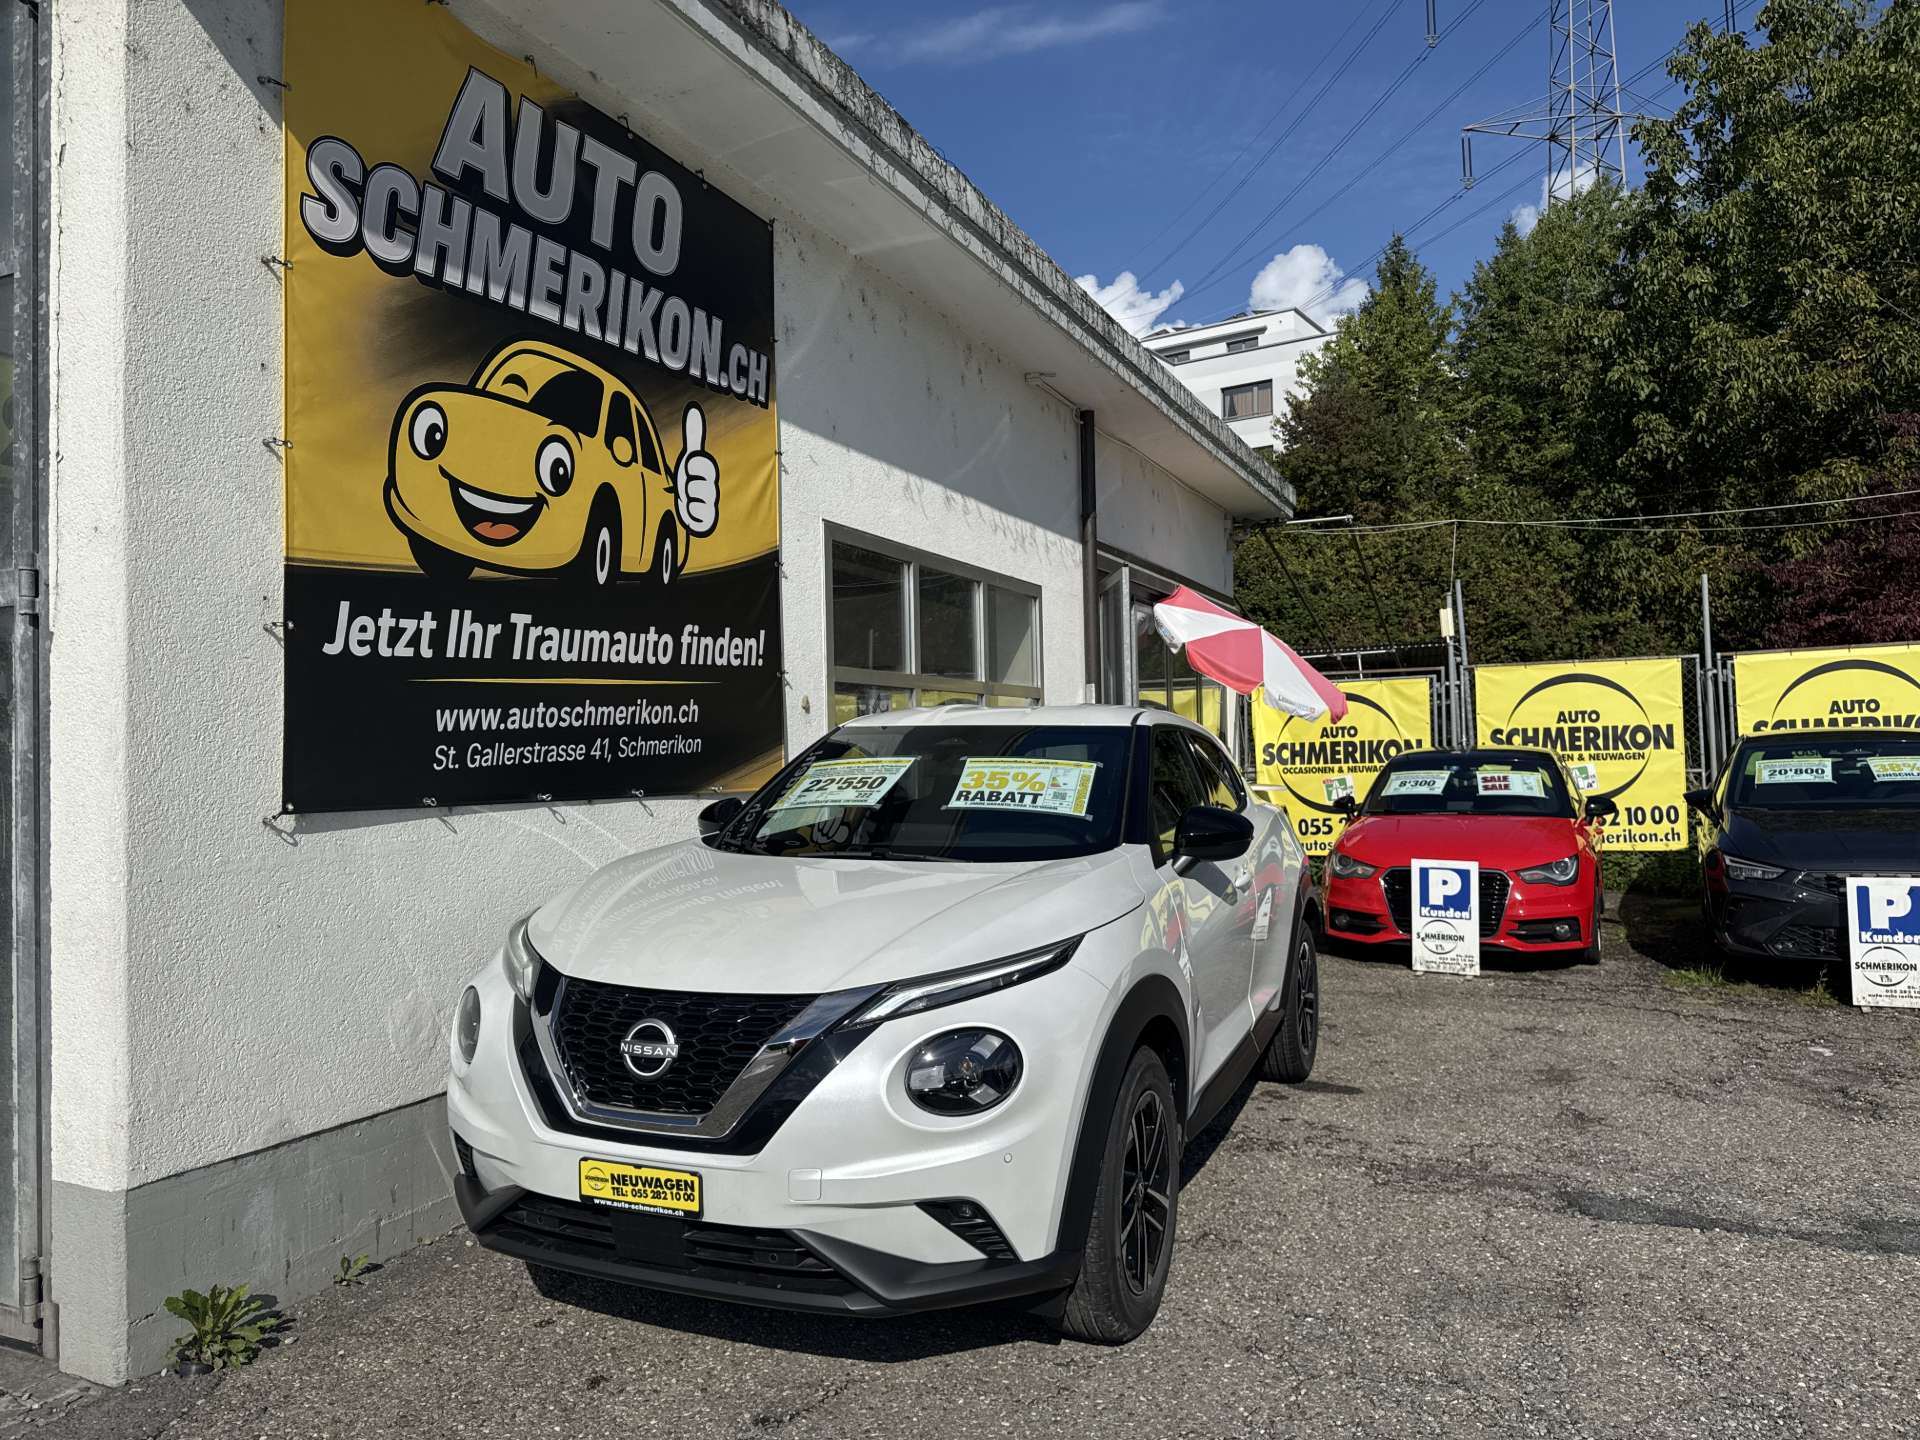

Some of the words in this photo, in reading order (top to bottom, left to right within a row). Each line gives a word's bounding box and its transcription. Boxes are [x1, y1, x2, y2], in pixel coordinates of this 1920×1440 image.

[431, 65, 684, 277] AUTO
[301, 136, 769, 405] SCHMERIKON.CH
[322, 600, 437, 659] Jetzt
[446, 608, 501, 660] Ihr
[509, 613, 674, 664] Traumauto
[680, 624, 766, 667] finden!
[435, 698, 699, 732] www.autoschmerikon.ch
[1828, 698, 1881, 715] AUTO
[1556, 709, 1601, 725] AUTO
[1320, 725, 1358, 739] AUTO
[1489, 723, 1675, 751] SCHMERIKON
[433, 744, 460, 771] St.
[466, 745, 586, 768] Gallerstrasse
[590, 739, 613, 763] 41,
[618, 735, 702, 758] Schmerikon
[1588, 751, 1645, 762] NEUWAGEN
[1282, 766, 1335, 775] OCCASIONEN
[1337, 766, 1344, 774] &
[1481, 775, 1511, 783] SALE
[1767, 767, 1826, 777] 20'800
[801, 775, 888, 793] 22'550
[961, 770, 1047, 793] 35%
[1398, 780, 1437, 788] 8'300
[1482, 783, 1512, 791] SALE
[955, 790, 1043, 805] RABATT
[1624, 806, 1647, 826] 10
[1650, 804, 1680, 825] 00
[1298, 817, 1334, 836] 055
[1601, 827, 1681, 844] erikon.ch
[1420, 906, 1471, 919] Kunden
[1855, 961, 1917, 971] SCHMERIKON
[621, 1042, 678, 1057] NISSAN
[610, 1173, 695, 1192] NEUWAGEN
[611, 1187, 628, 1197] TEL:
[631, 1188, 648, 1199] 055
[651, 1190, 668, 1201] 282
[670, 1192, 681, 1201] 10
[683, 1193, 695, 1202] 00
[593, 1198, 684, 1217] www.auto-schmerikon.ch
